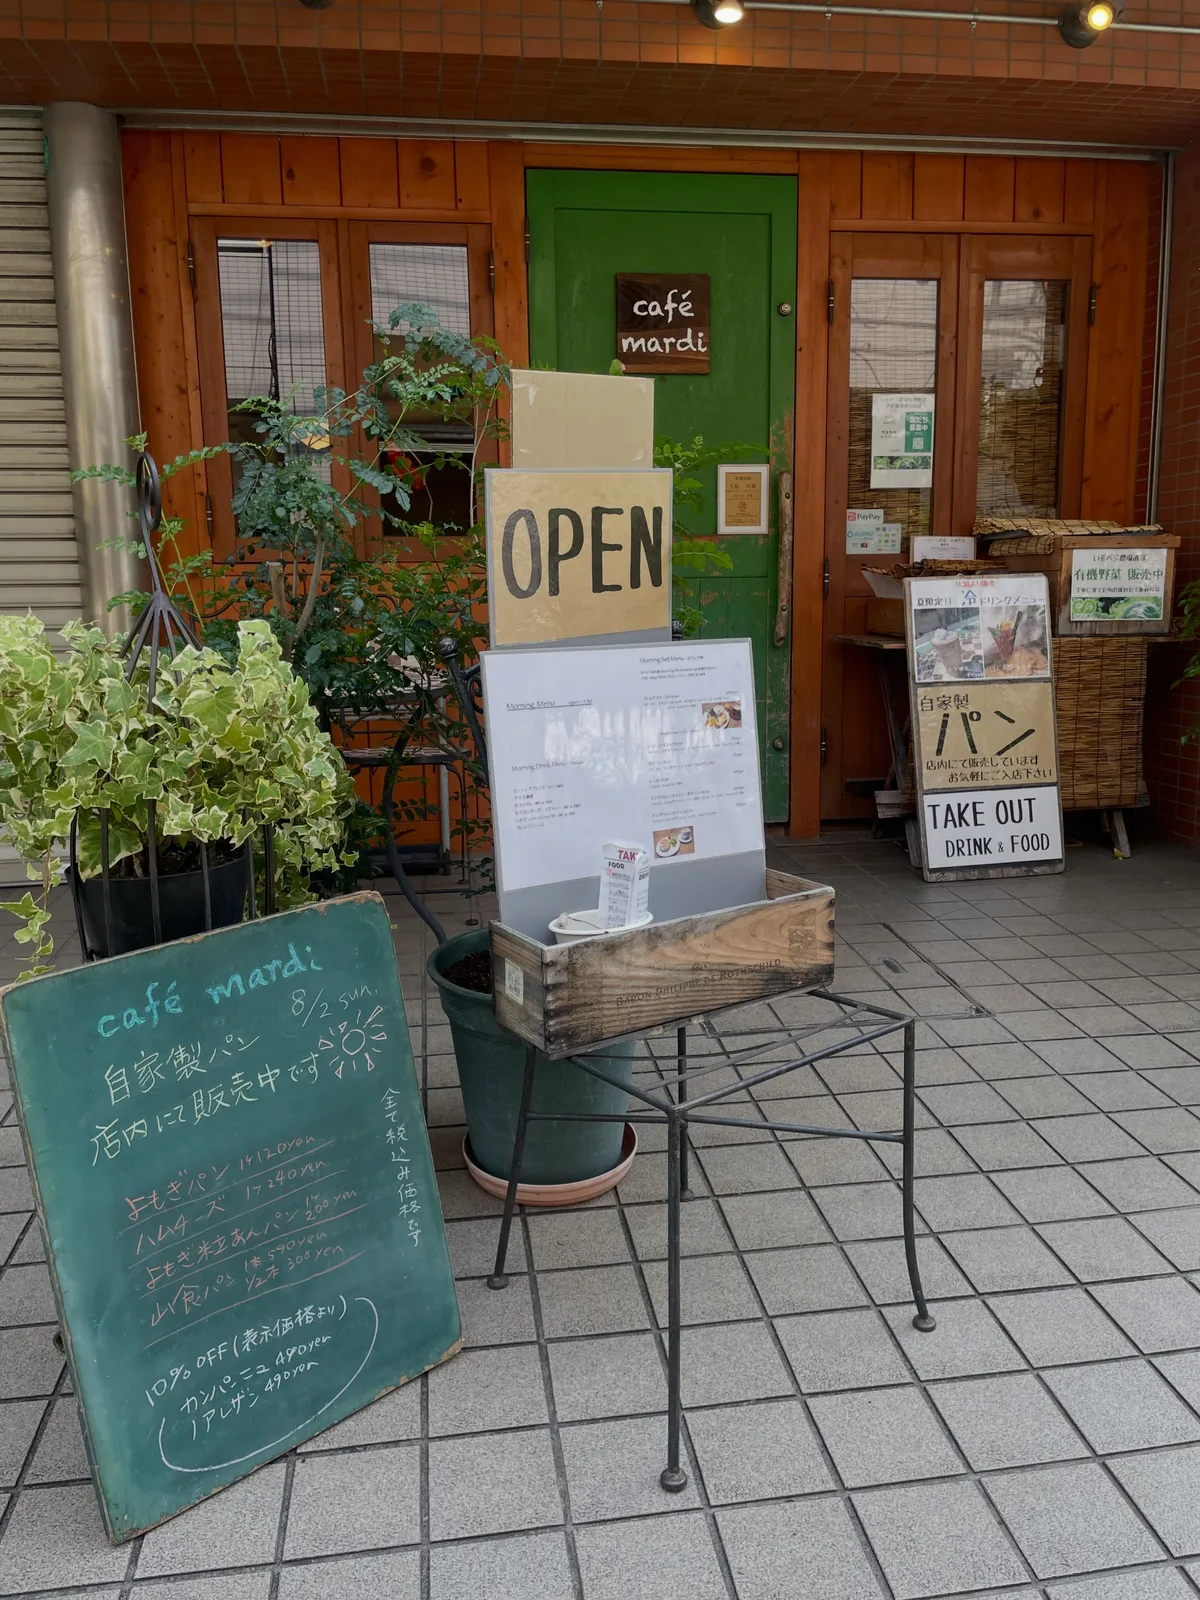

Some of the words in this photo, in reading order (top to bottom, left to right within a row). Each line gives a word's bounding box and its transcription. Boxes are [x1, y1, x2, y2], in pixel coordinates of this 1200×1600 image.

[632, 289, 695, 323] café
[621, 328, 708, 354] mardi
[501, 505, 663, 599] OPEN
[1074, 568, 1122, 581] 有機野菜
[1127, 568, 1164, 581] 販売中
[961, 589, 977, 606] 冷
[506, 703, 535, 711] Morning
[920, 693, 969, 712] 自家製
[935, 710, 1036, 757] パン
[511, 764, 536, 772] Morning
[926, 755, 1039, 771] 店内にて販売しています
[948, 768, 1052, 783] お気軽にご入店下さい
[927, 801, 985, 829] TAKE
[995, 797, 1036, 825] OUT
[618, 849, 638, 861] TAK
[945, 837, 992, 858] DRINK
[998, 841, 1004, 853] &
[1010, 833, 1049, 853] FOOD
[608, 861, 625, 869] FOOD
[97, 981, 184, 1037] café
[206, 942, 324, 1004] mardi
[616, 992, 652, 1007] BARON
[720, 959, 781, 981] ROTHSCHILD
[290, 988, 332, 1027] 8/2
[104, 1035, 260, 1106] 自家製パン
[92, 1051, 320, 1167] 店内にて販売中です
[380, 1086, 422, 1248] 全て税込み価格です
[125, 1163, 230, 1220] よもぎパン
[136, 1195, 226, 1255] ハムチーズ
[145, 1364, 192, 1407] 10%
[196, 1341, 229, 1369] OFF
